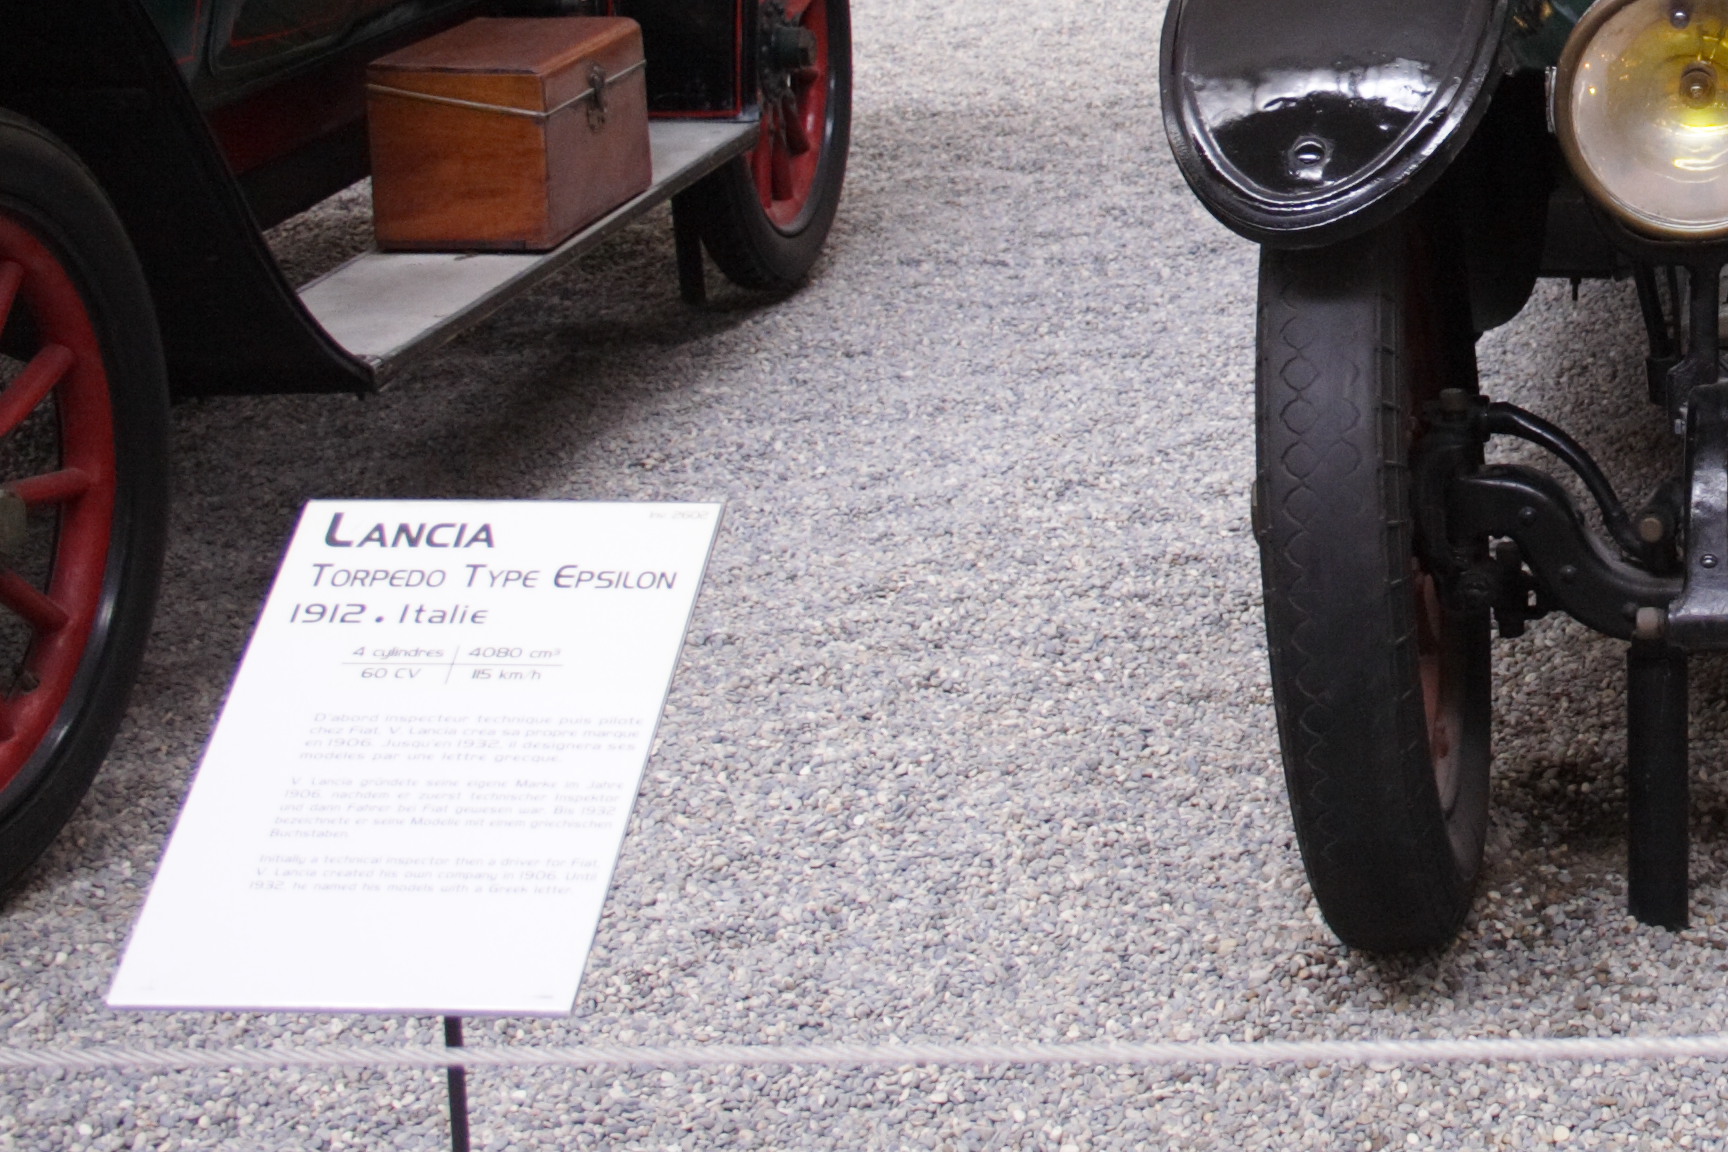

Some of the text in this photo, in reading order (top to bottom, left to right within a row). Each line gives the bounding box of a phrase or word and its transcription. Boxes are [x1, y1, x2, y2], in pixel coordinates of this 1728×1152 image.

[398, 603, 489, 625] Italie
[352, 646, 444, 660] 4 cylindres
[468, 647, 523, 659] 4080
[360, 667, 422, 679] 60 CV
